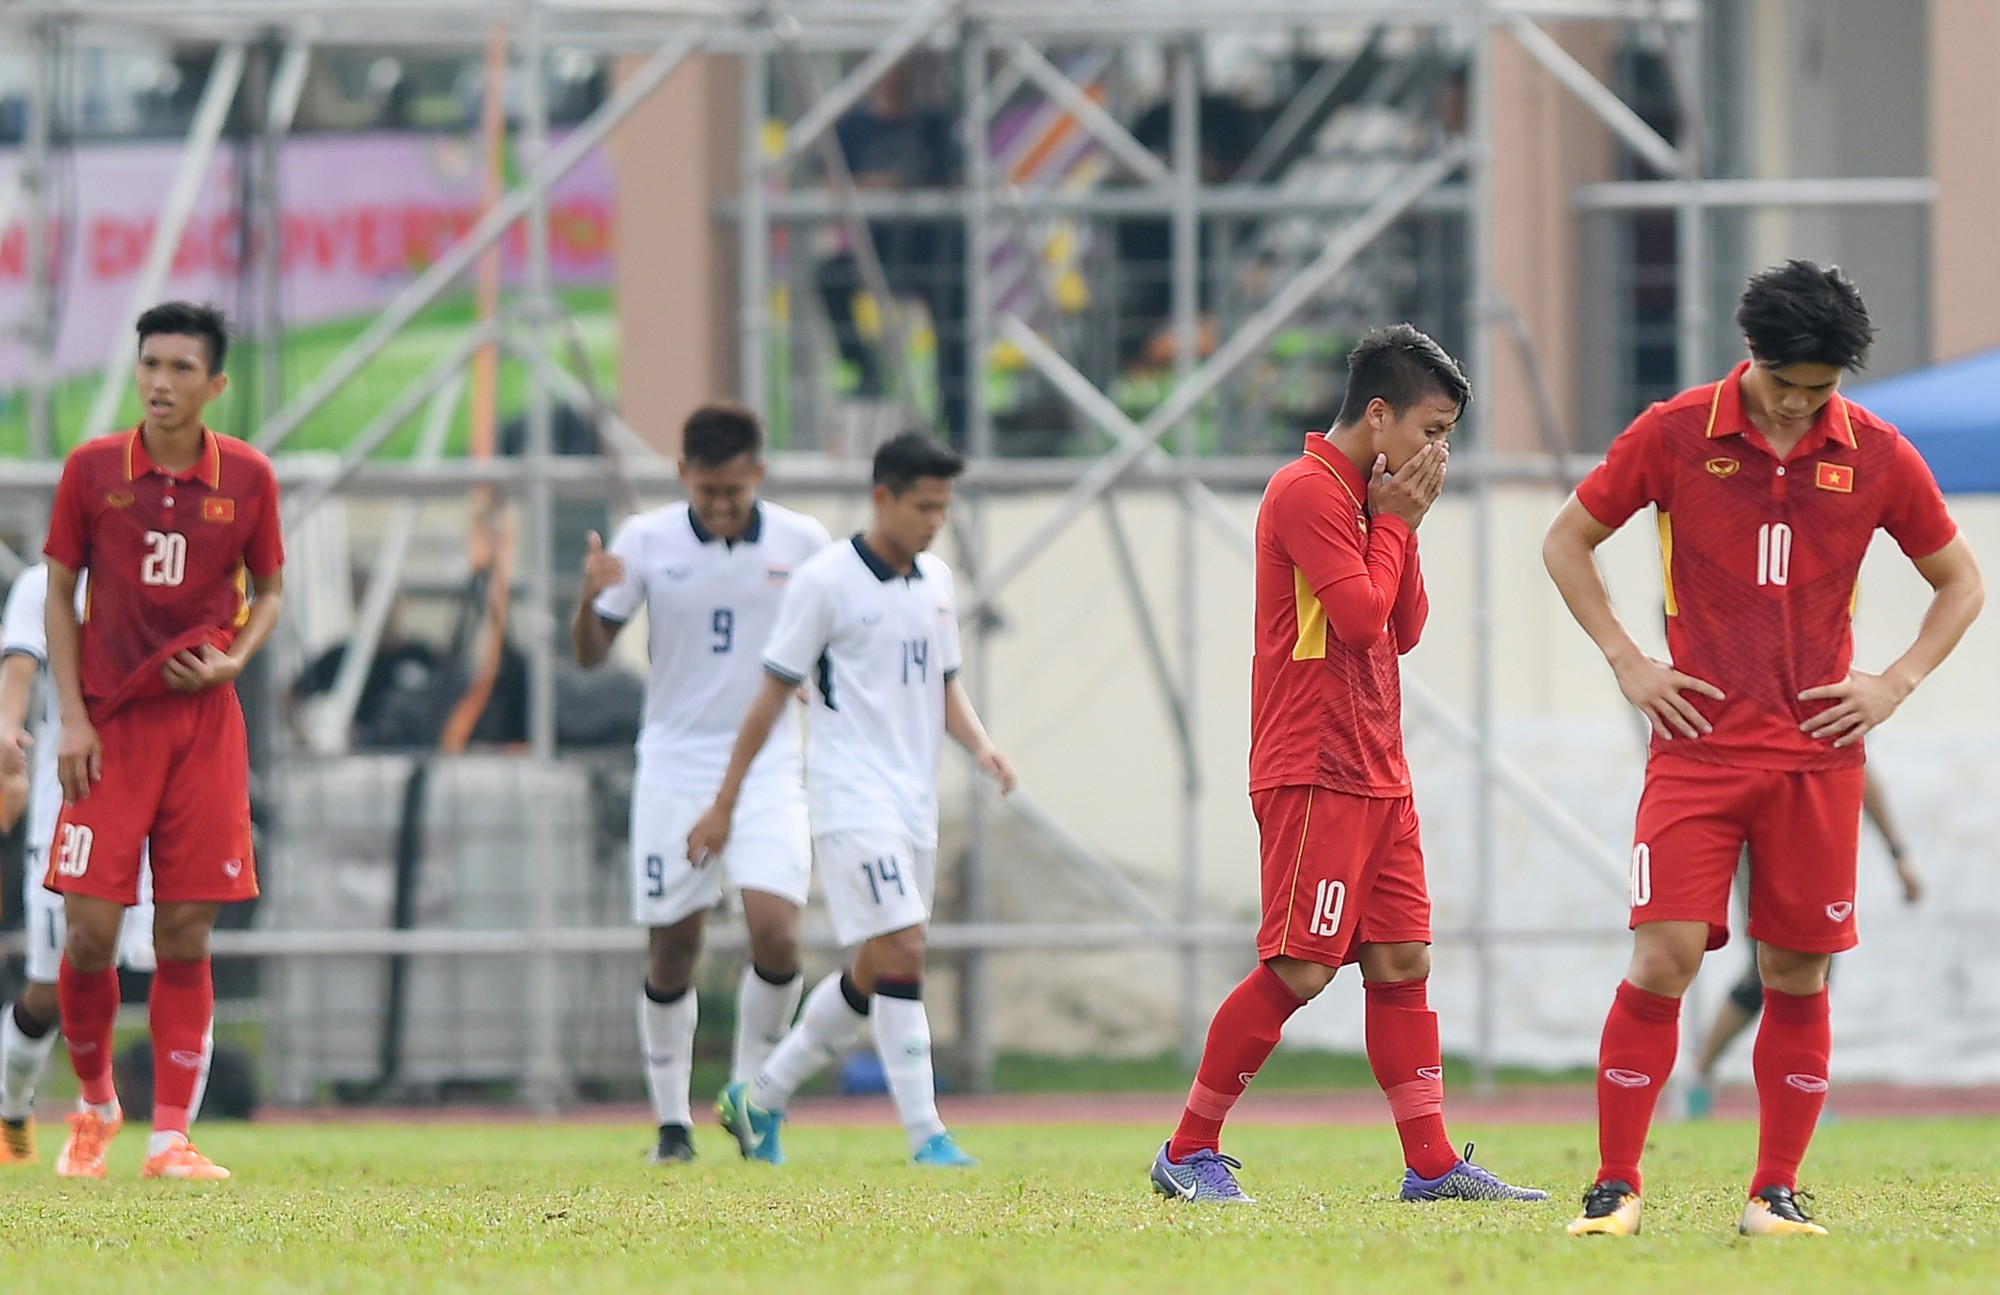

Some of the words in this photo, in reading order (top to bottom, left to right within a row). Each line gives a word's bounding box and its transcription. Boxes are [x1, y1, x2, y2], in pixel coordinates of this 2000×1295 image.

[142, 530, 187, 587] 20
[1757, 522, 1792, 586] 10
[712, 608, 733, 654] 9
[901, 638, 928, 686] 14
[58, 821, 94, 879] 20
[646, 854, 665, 898] 9
[862, 854, 905, 905] 14
[1309, 878, 1346, 937] 19
